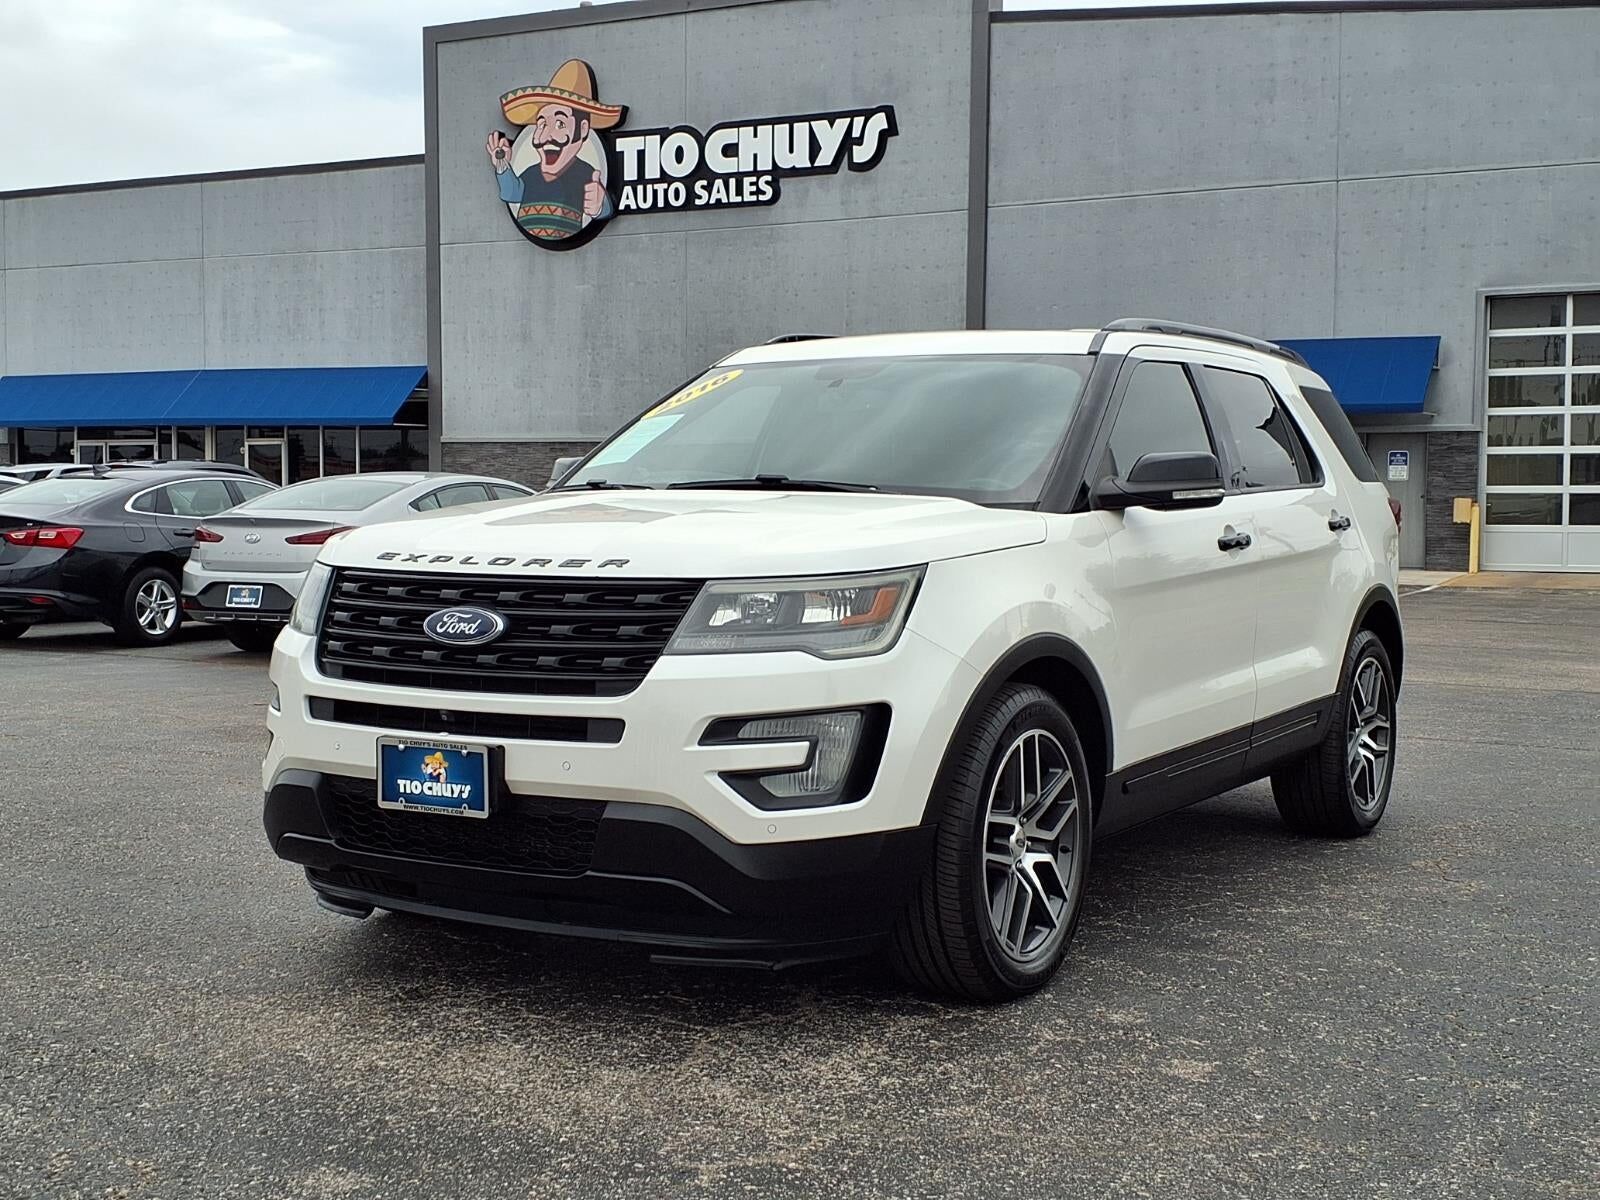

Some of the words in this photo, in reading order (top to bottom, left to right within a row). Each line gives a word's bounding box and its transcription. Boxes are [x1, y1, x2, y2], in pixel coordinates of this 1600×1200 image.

[615, 132, 699, 182] TIO
[704, 112, 889, 174] CHUY'S
[618, 182, 686, 211] AUTO
[694, 176, 773, 206] SALES
[376, 552, 631, 568] EXPLORER
[436, 612, 482, 635] Ford
[397, 779, 422, 795] TIO
[422, 782, 471, 799] CHUY'S
